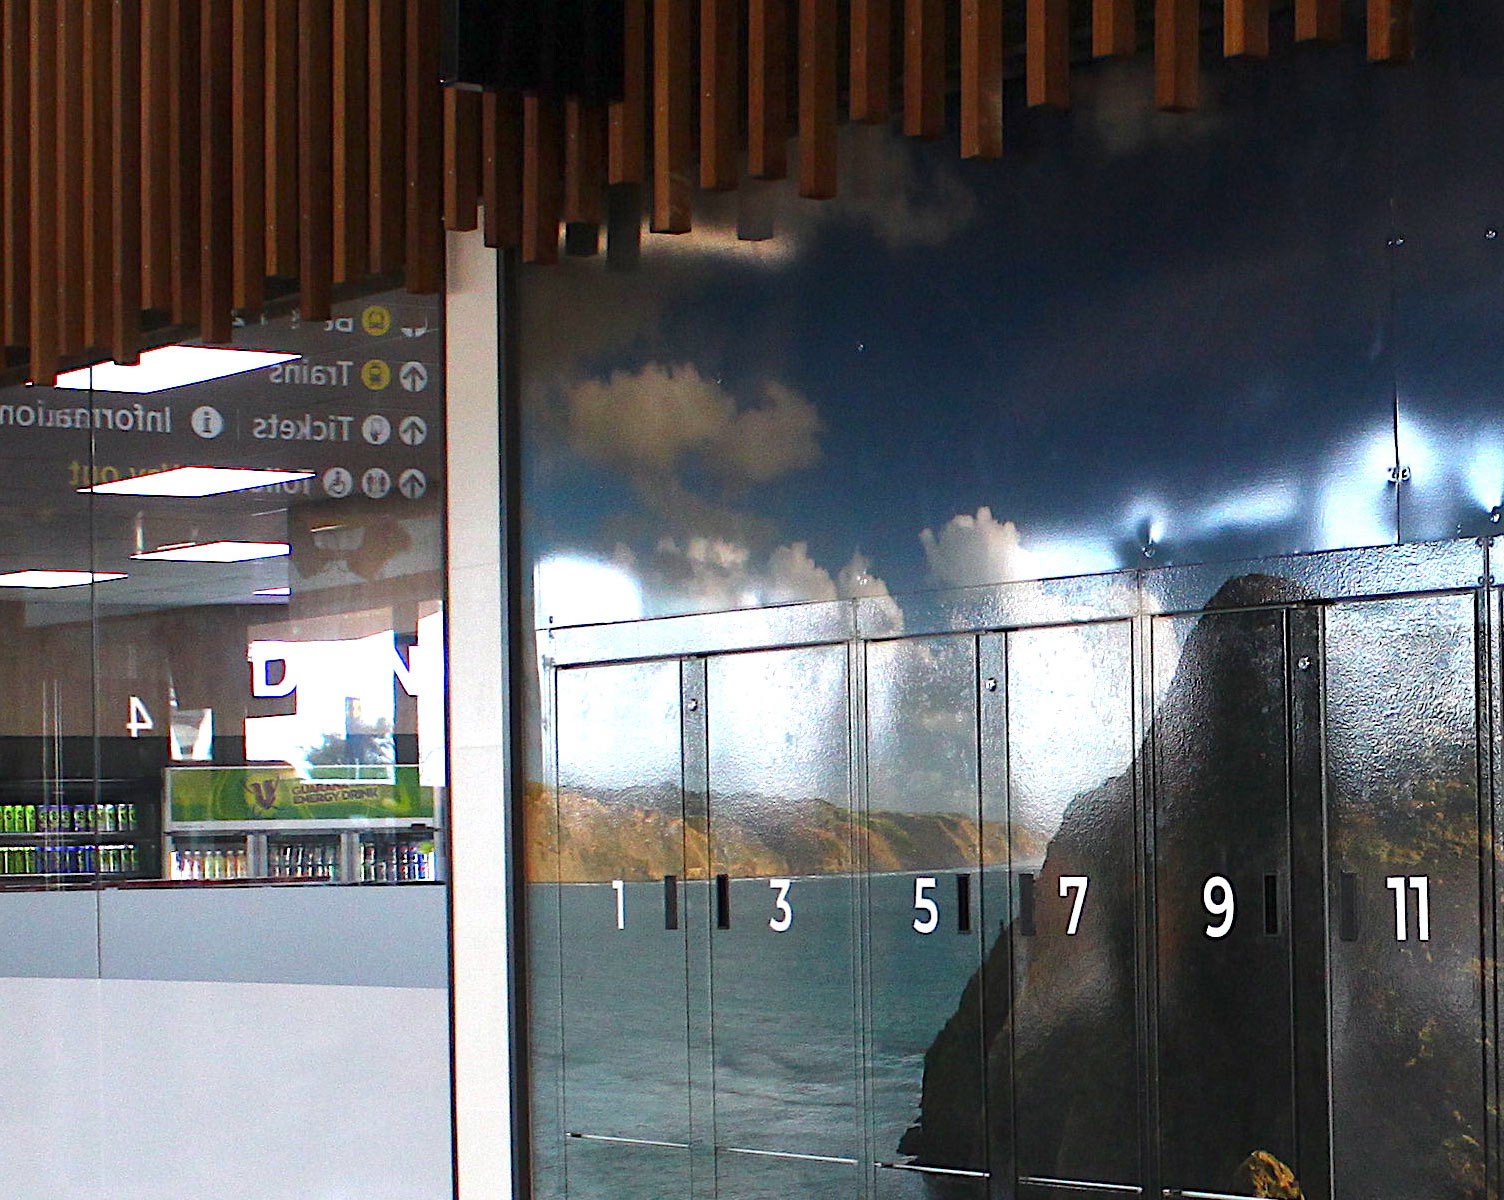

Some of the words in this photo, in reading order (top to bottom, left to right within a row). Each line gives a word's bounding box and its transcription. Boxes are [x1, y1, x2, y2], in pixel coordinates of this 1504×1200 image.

[611, 879, 625, 930] 1
[769, 878, 794, 932] 3
[912, 877, 939, 933] 5
[1058, 875, 1089, 935] 7
[1202, 875, 1236, 938] 9
[1386, 875, 1430, 942] 11
